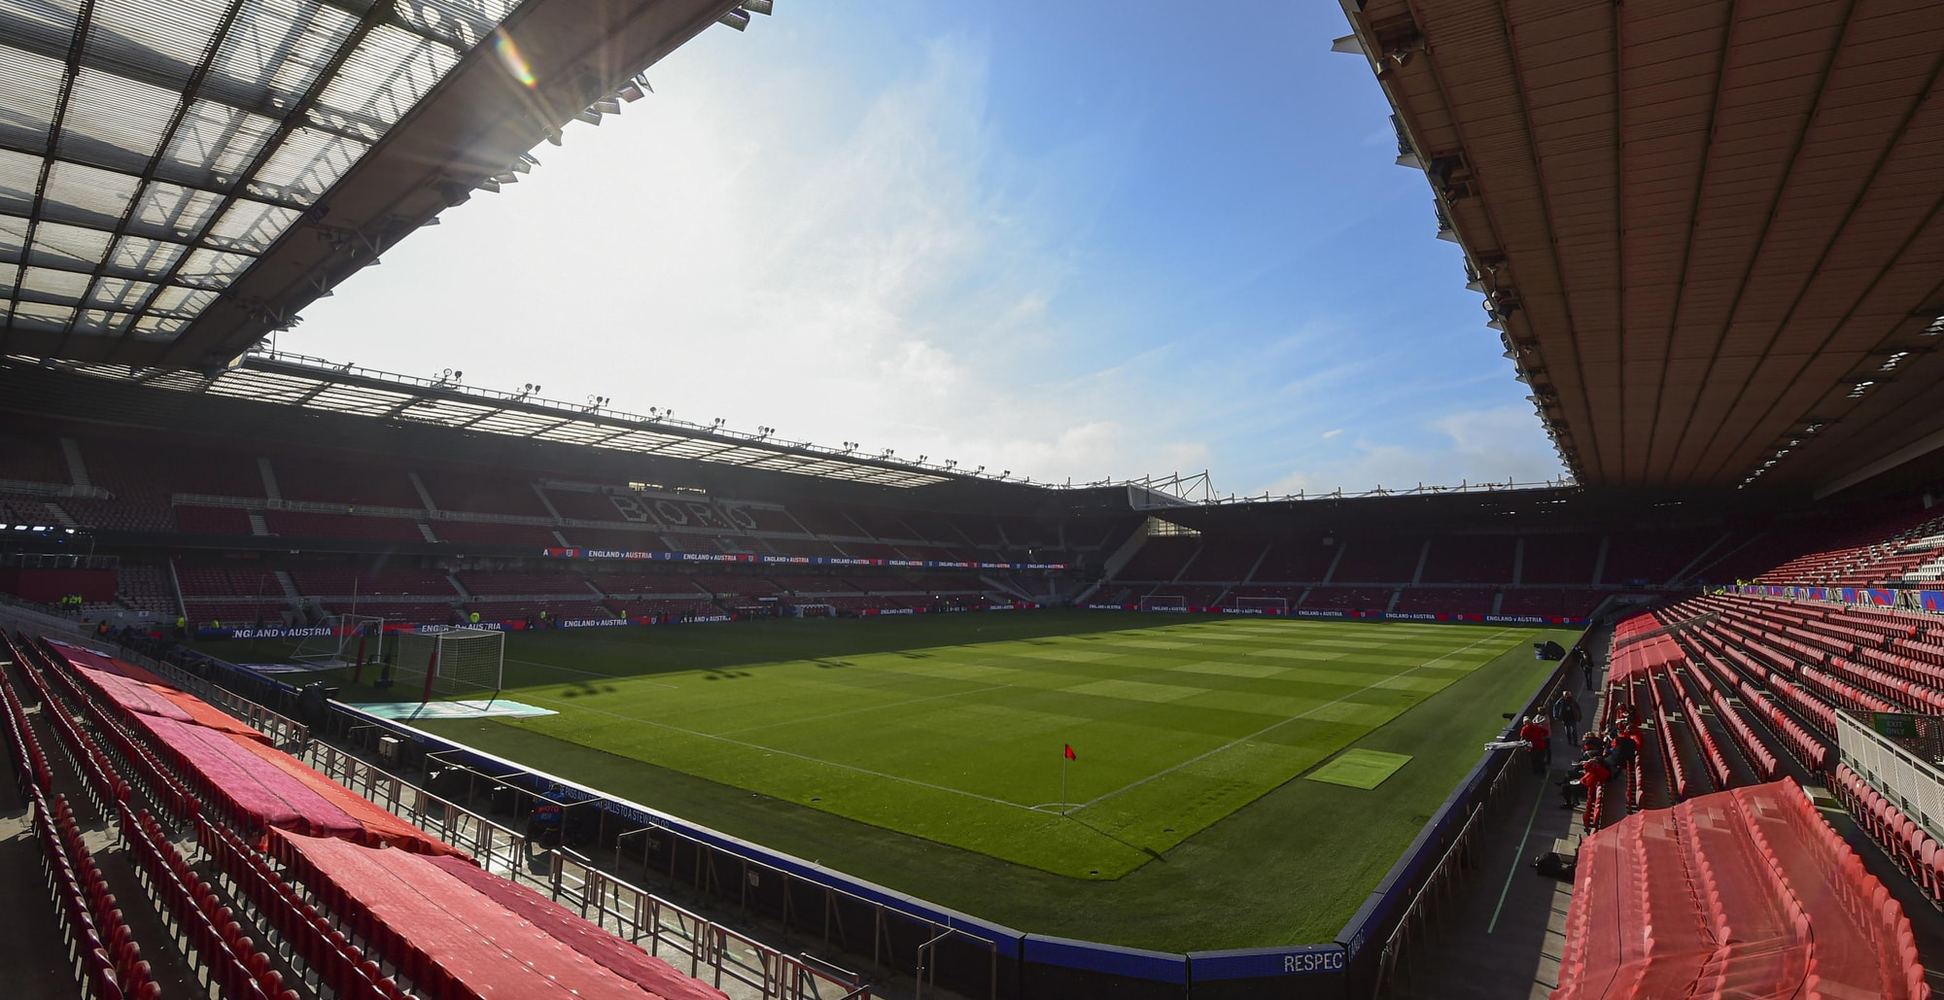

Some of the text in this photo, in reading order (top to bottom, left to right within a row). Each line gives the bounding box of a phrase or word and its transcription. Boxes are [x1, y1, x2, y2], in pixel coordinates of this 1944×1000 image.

[589, 550, 620, 558] ENGLAND
[625, 551, 652, 559] AUSTRIA
[564, 619, 596, 627] ENGLAND
[600, 618, 628, 626] AUSTRIA
[288, 628, 331, 636] AUSTRIA
[604, 801, 620, 815] BALLS
